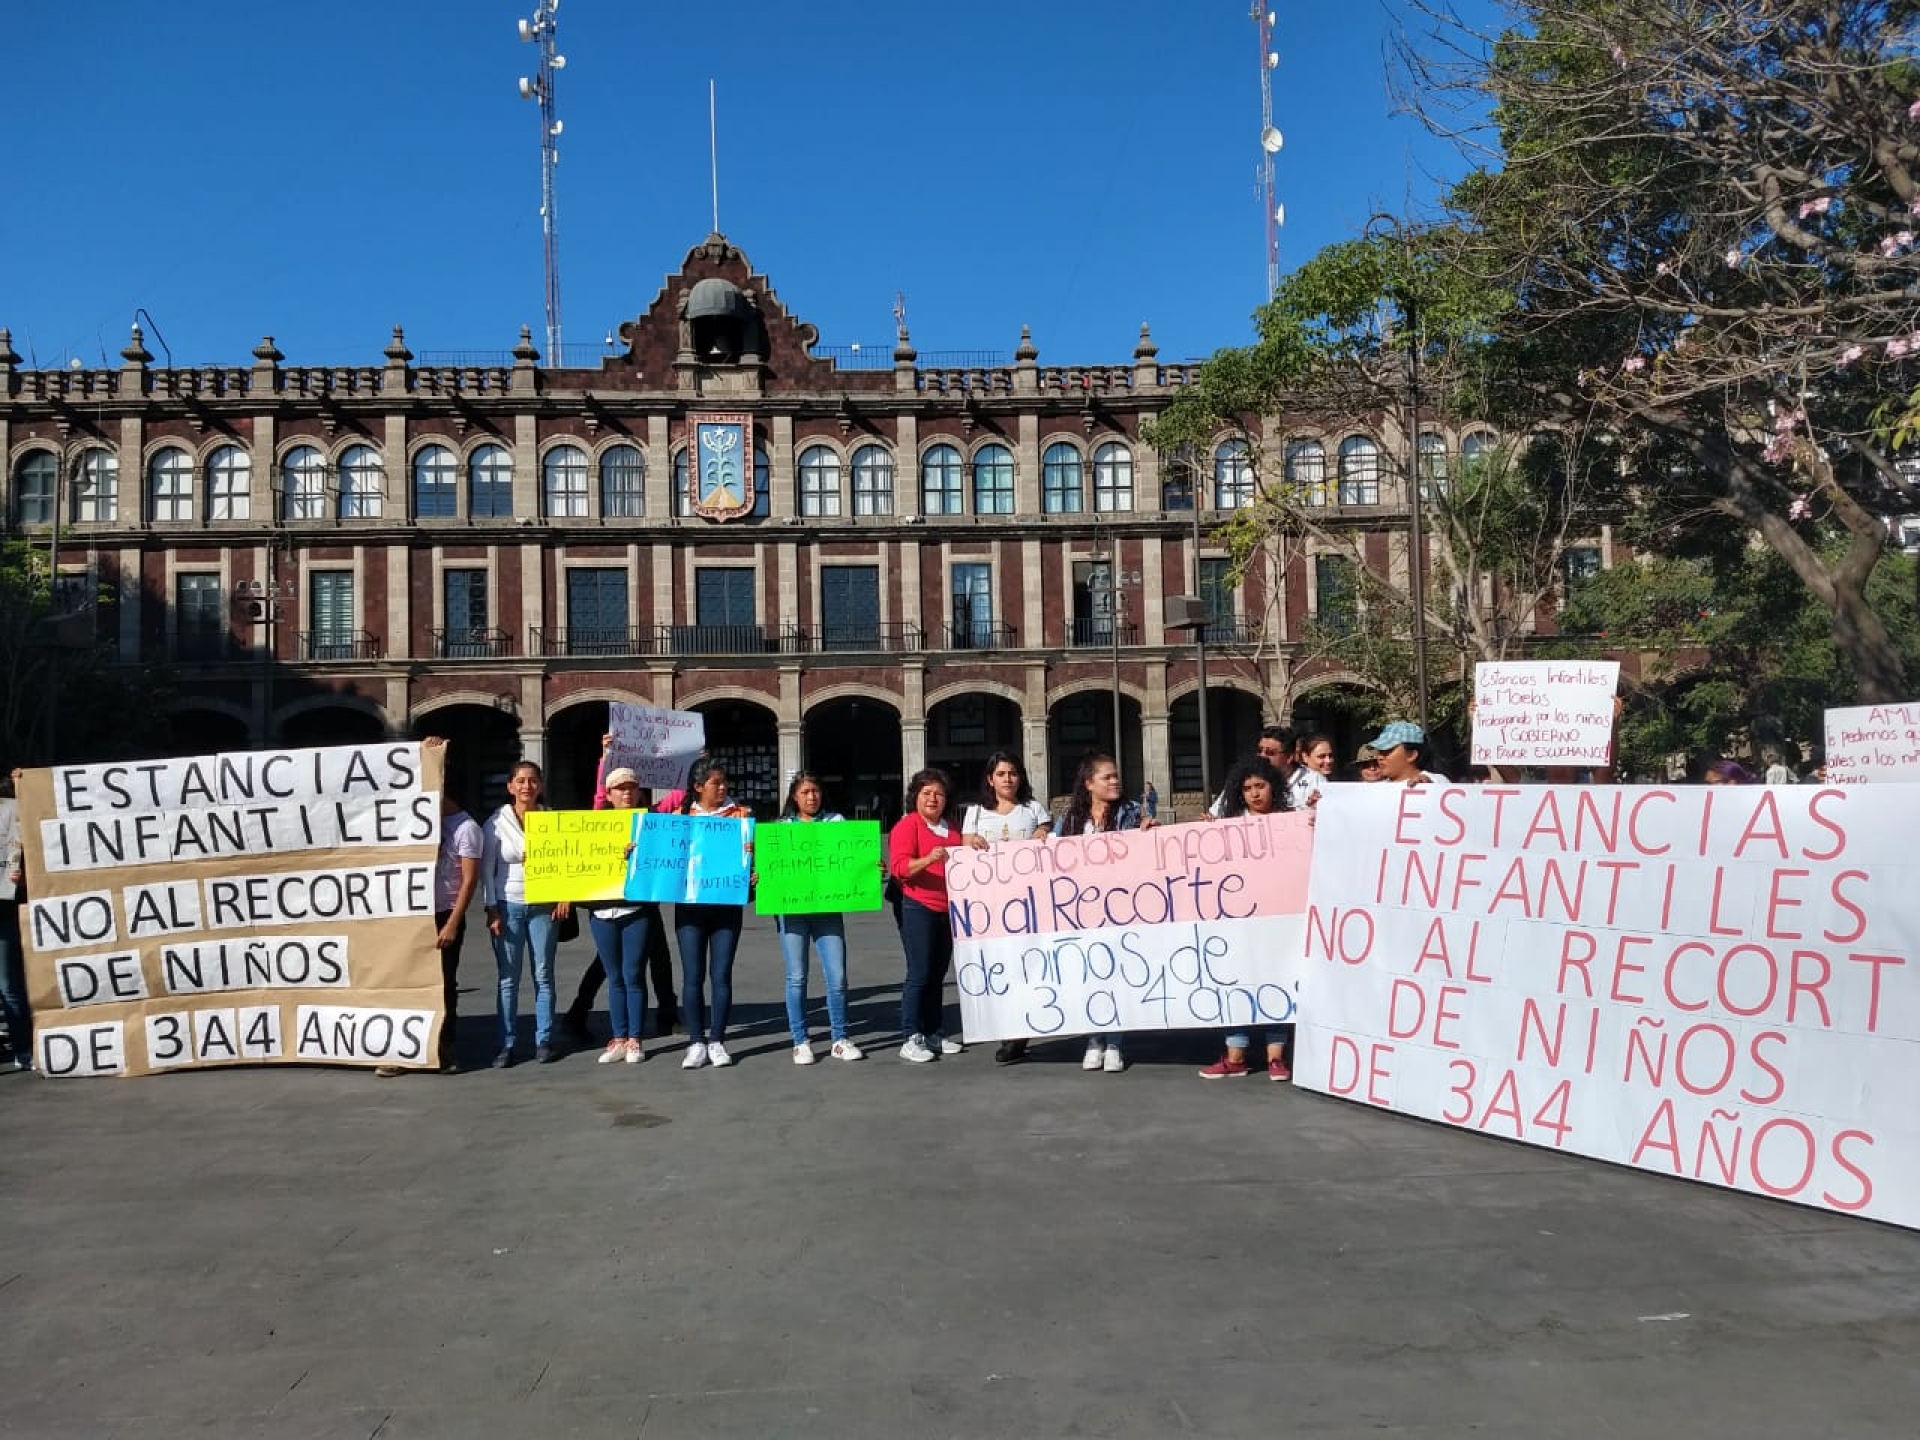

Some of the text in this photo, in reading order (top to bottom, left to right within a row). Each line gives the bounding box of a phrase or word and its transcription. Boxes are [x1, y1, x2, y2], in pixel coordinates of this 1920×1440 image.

[1869, 707, 1920, 725] AML
[64, 747, 415, 811] ESTANCIAS
[60, 797, 434, 865] INFANTILES
[1395, 787, 1848, 861] ESTANCIAS
[948, 831, 1128, 892] Estancias
[1375, 849, 1870, 944] INFANTILES
[34, 867, 429, 947] NO AL RECORTE
[1002, 886, 1038, 934] al
[1050, 867, 1257, 931] Recorte
[61, 941, 343, 1003] DE NIÑOS
[959, 950, 1009, 997] de
[1170, 923, 1239, 987] de
[1304, 905, 1905, 1032] NO AL RECORT
[1025, 987, 1065, 1034] 3
[1086, 990, 1121, 1027] a
[1140, 964, 1177, 1029] 4
[44, 1026, 118, 1075] DE
[300, 1010, 425, 1059] AÑOS
[1388, 979, 1788, 1105] DE NIÑOS
[1329, 1036, 1395, 1106] DE
[1632, 1098, 1874, 1211] AÑOS
